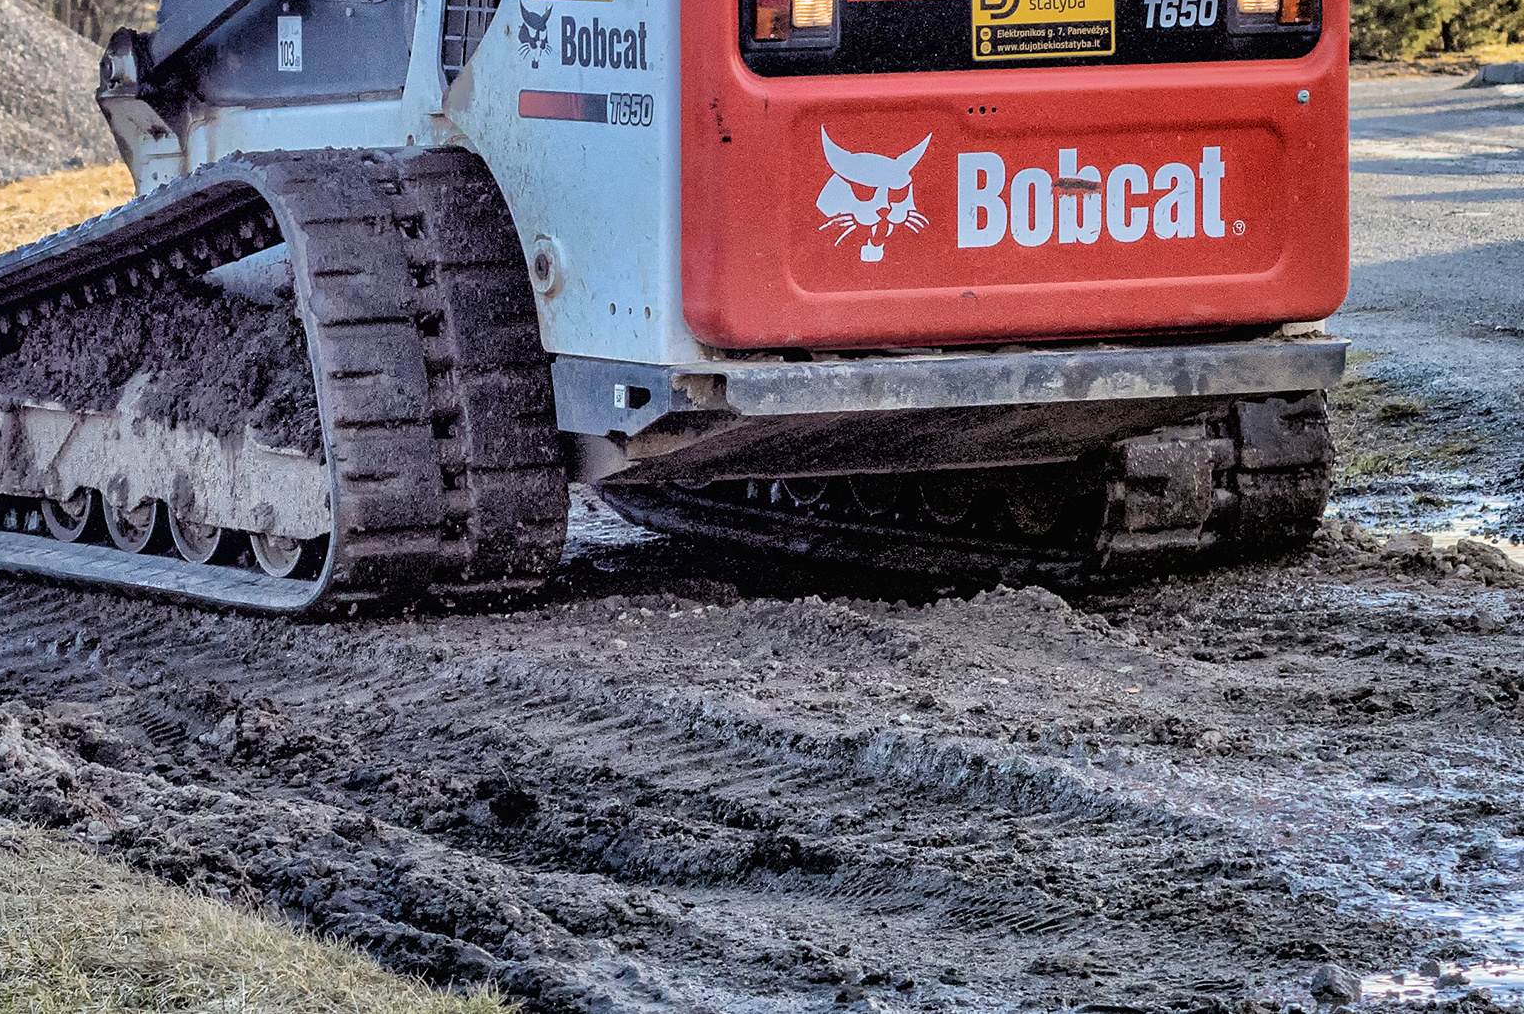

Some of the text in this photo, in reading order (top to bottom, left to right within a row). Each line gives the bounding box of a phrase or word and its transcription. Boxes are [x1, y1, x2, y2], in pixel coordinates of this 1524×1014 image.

[561, 15, 647, 71] Bobcat
[997, 28, 1046, 39] Elektronikos
[1047, 29, 1056, 38] g.
[997, 39, 1101, 52] www.dujotiekiostatyba.lt
[280, 40, 294, 67] 103
[610, 92, 654, 127] T650
[957, 146, 1226, 248] Bobcat
